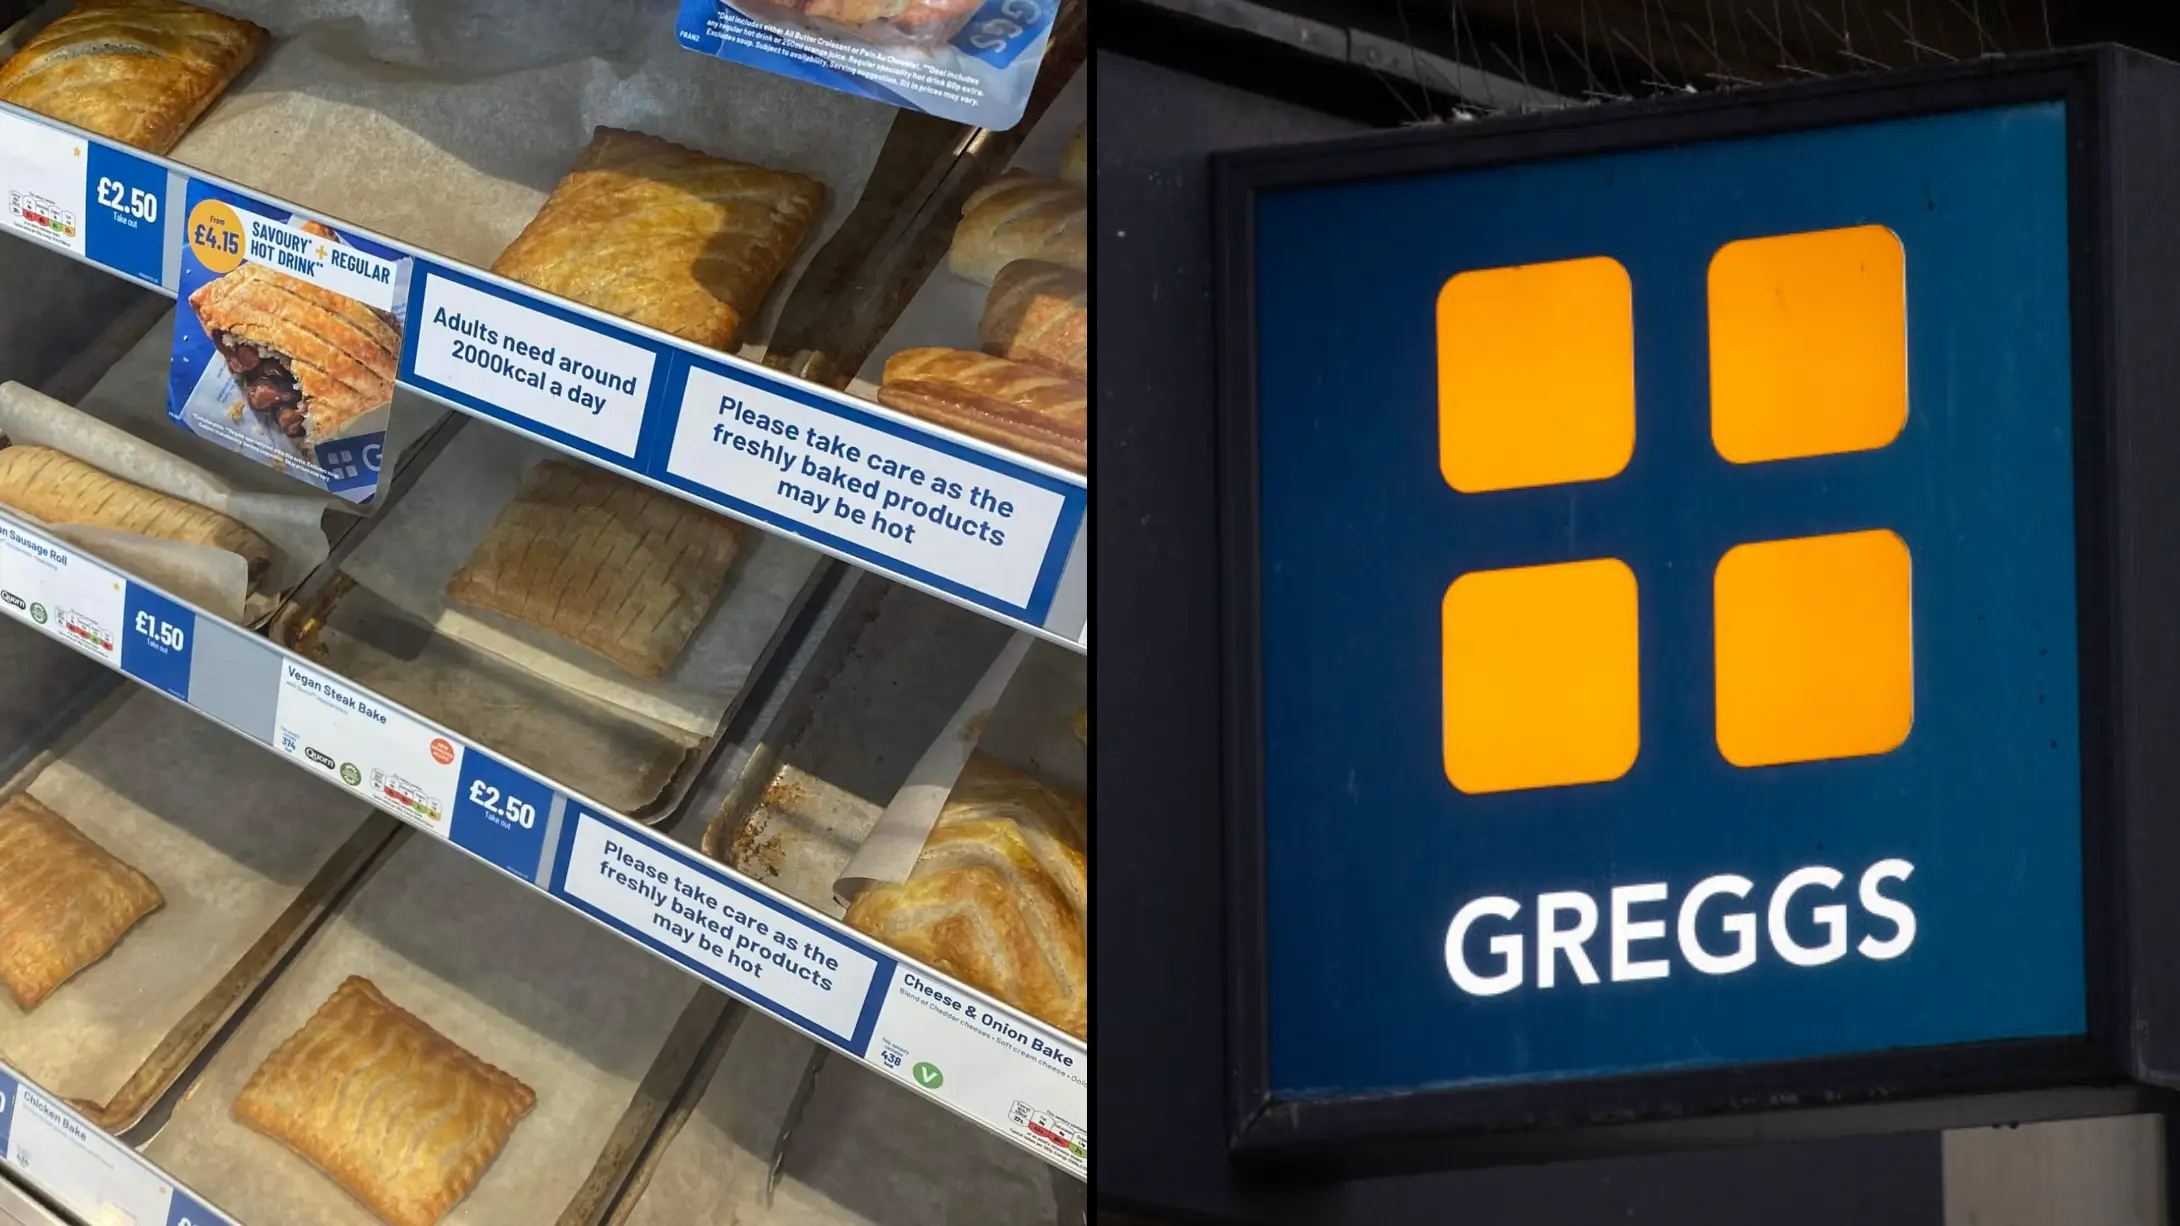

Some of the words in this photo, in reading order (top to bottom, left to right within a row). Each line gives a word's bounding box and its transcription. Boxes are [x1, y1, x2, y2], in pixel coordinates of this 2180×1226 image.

[706, 28, 736, 43] Excludes
[736, 36, 754, 48] soup.
[755, 41, 781, 55] Subject
[781, 48, 790, 57] to
[829, 60, 857, 75] Serving
[911, 82, 918, 90] in
[943, 90, 960, 102] may
[707, 19, 719, 30] any
[719, 22, 743, 36] regular
[743, 27, 755, 37] hot
[756, 31, 773, 43] drink
[774, 36, 781, 44] or
[781, 37, 803, 50] 250ml
[912, 72, 926, 82] hot
[926, 76, 945, 87] drink
[735, 13, 763, 30] includes
[764, 23, 783, 35] either
[795, 31, 817, 44] Butter
[851, 46, 859, 54] or
[860, 48, 877, 60] Pain
[877, 52, 886, 61] Au
[947, 68, 979, 85] includes
[97, 177, 158, 223] £2.50
[113, 212, 127, 225] Take
[127, 220, 138, 229] out
[210, 216, 225, 226] From
[194, 224, 239, 254] £4.15
[250, 240, 275, 260] HOT
[331, 250, 391, 284] REGULAR
[433, 307, 498, 345] Adults
[503, 334, 555, 366] need
[559, 354, 637, 396] around
[452, 339, 546, 390] 2000kcal
[549, 380, 563, 397] a
[567, 385, 607, 415] day
[712, 423, 798, 472] freshly
[801, 455, 881, 500] baked
[882, 489, 1005, 547] products
[718, 395, 800, 440] Please
[806, 428, 861, 462] take
[867, 453, 926, 486] care
[930, 477, 961, 499] as
[970, 486, 1014, 518] the
[776, 479, 831, 514] may
[834, 497, 866, 525] be
[871, 510, 917, 544] hot
[9, 529, 49, 556] Sausage
[50, 549, 68, 566] Roll
[135, 610, 184, 651] £1.50
[288, 665, 322, 691] Vegan
[323, 685, 356, 710] Steak
[358, 702, 387, 724] Bake
[305, 747, 335, 769] Quorn
[469, 780, 536, 829] £2.50
[485, 811, 500, 825] Take
[500, 820, 511, 830] out
[599, 861, 667, 908] freshly
[671, 896, 734, 940] baked
[735, 929, 833, 991] products
[603, 840, 669, 884] Please
[674, 877, 718, 909] take
[723, 904, 769, 935] care
[773, 929, 799, 951] as
[804, 942, 839, 972] the
[1444, 857, 1917, 997] GREGGS
[652, 912, 695, 944] may
[698, 932, 725, 957] be
[728, 946, 763, 979] hot
[899, 987, 920, 1003] Blend
[920, 997, 929, 1006] of
[929, 1000, 960, 1022] Cheddar
[960, 1019, 991, 1040] cheeses
[996, 1036, 1013, 1051] Soft
[1013, 1046, 1038, 1063] cream
[1038, 1057, 1066, 1077] cheese
[904, 973, 962, 1012] Cheese
[964, 1005, 977, 1020] &
[981, 1013, 1028, 1046] Onion
[1031, 1037, 1074, 1068] Bake
[881, 1050, 902, 1067] 438
[921, 1065, 938, 1083] V
[24, 1091, 61, 1125] Chicken
[62, 1118, 87, 1141] Bake
